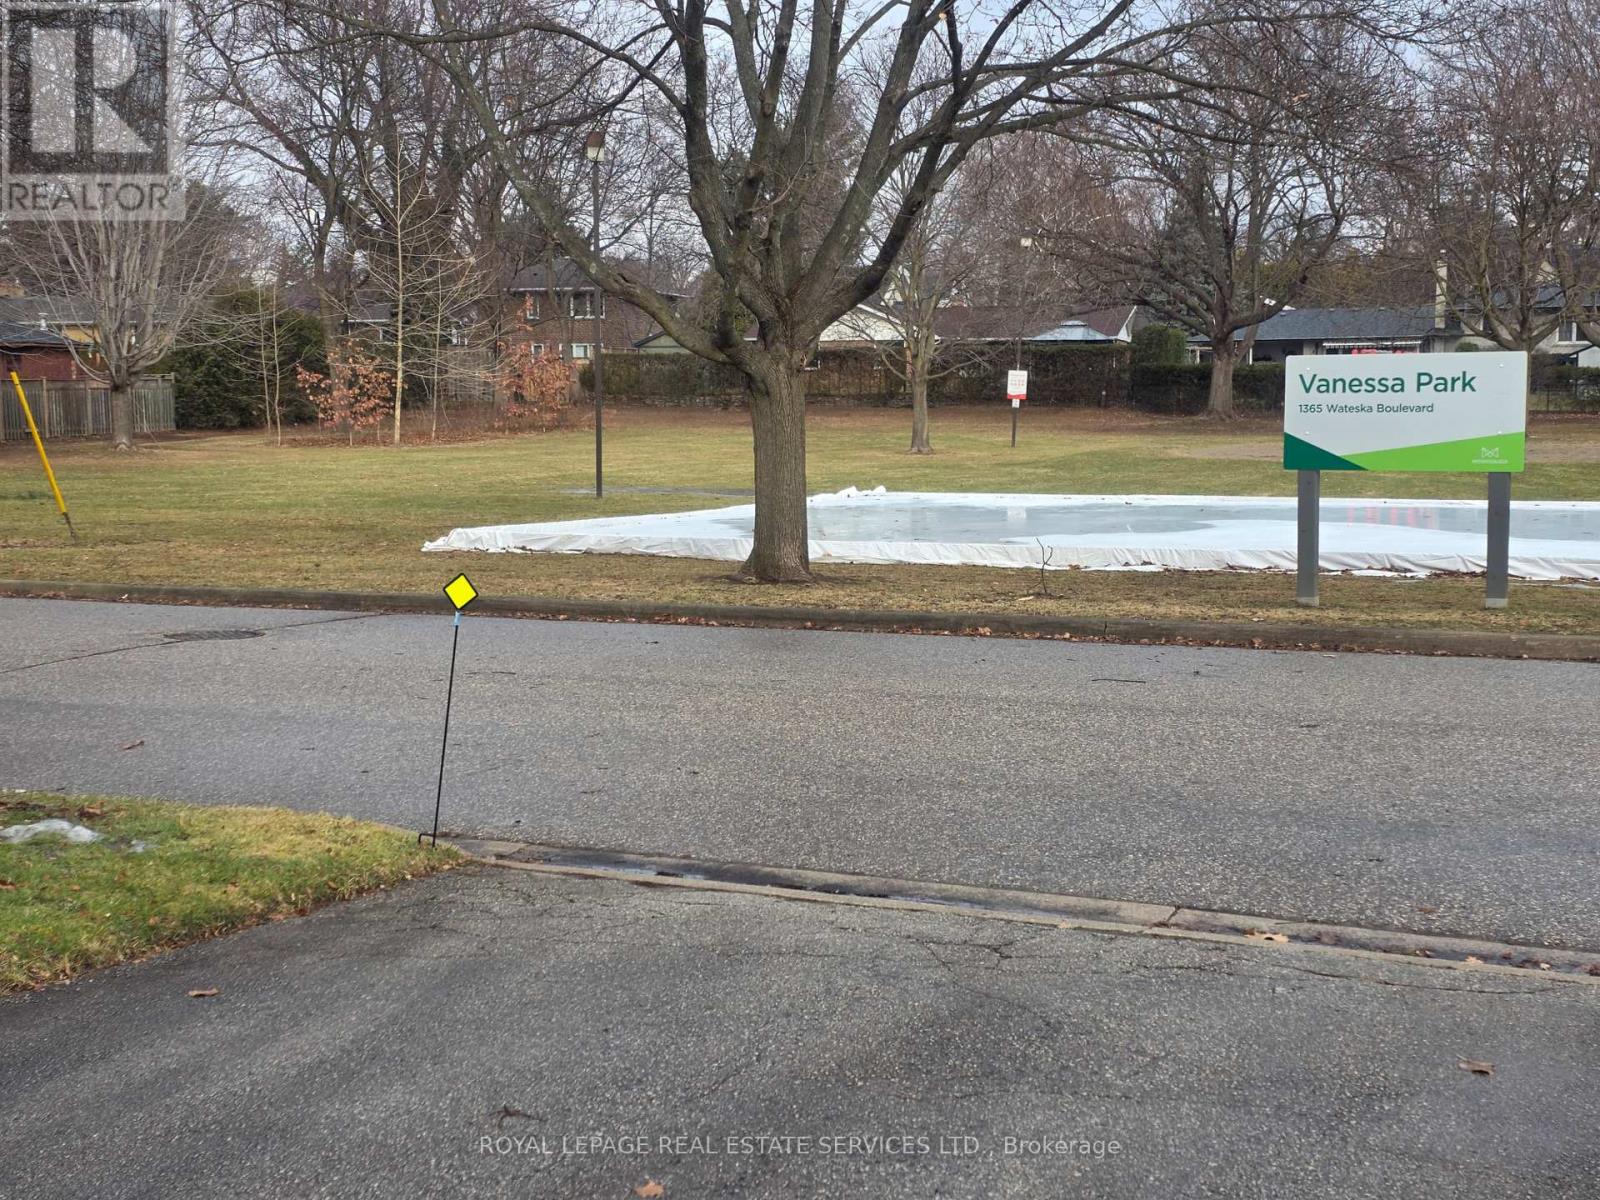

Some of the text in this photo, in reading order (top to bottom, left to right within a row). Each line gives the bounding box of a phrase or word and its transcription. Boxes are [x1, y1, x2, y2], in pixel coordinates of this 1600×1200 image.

[1298, 370, 1477, 394] Vanessa Park
[1298, 403, 1434, 414] 1365 Wateska Boulevard
